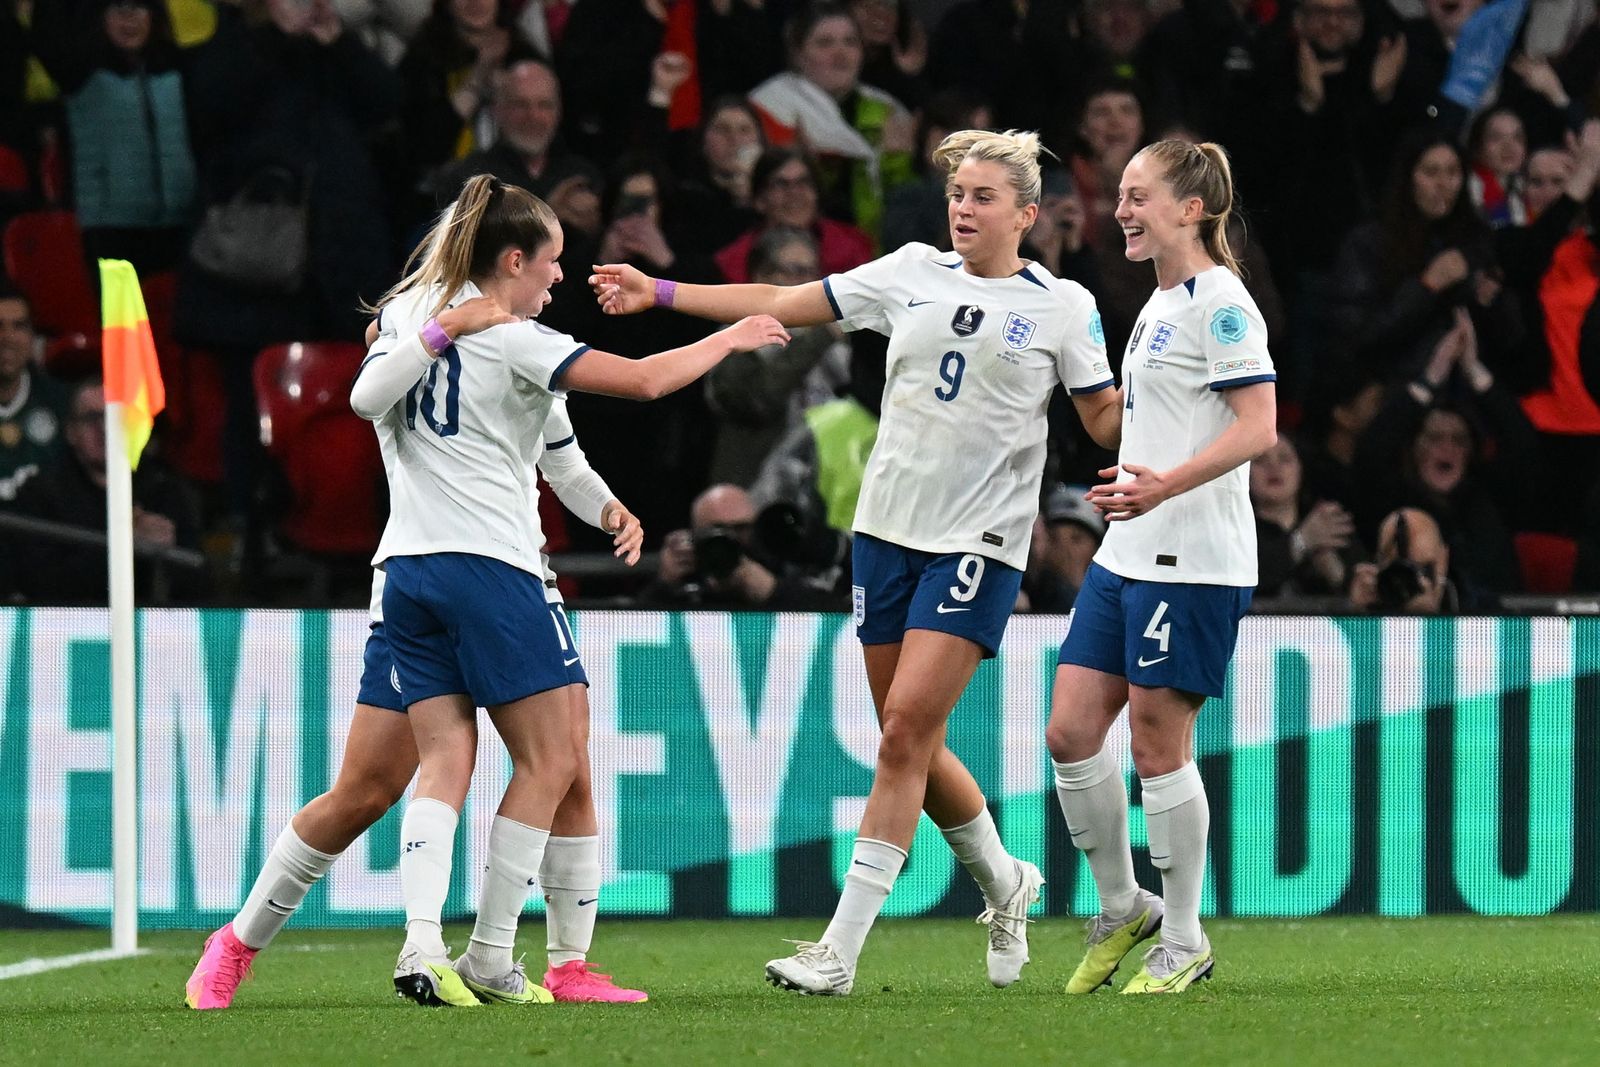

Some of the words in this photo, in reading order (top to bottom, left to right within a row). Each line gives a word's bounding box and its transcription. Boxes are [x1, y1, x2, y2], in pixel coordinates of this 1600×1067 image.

[406, 343, 462, 438] 10
[935, 350, 966, 402] 9
[949, 554, 986, 603] 9
[1143, 600, 1171, 652] 4
